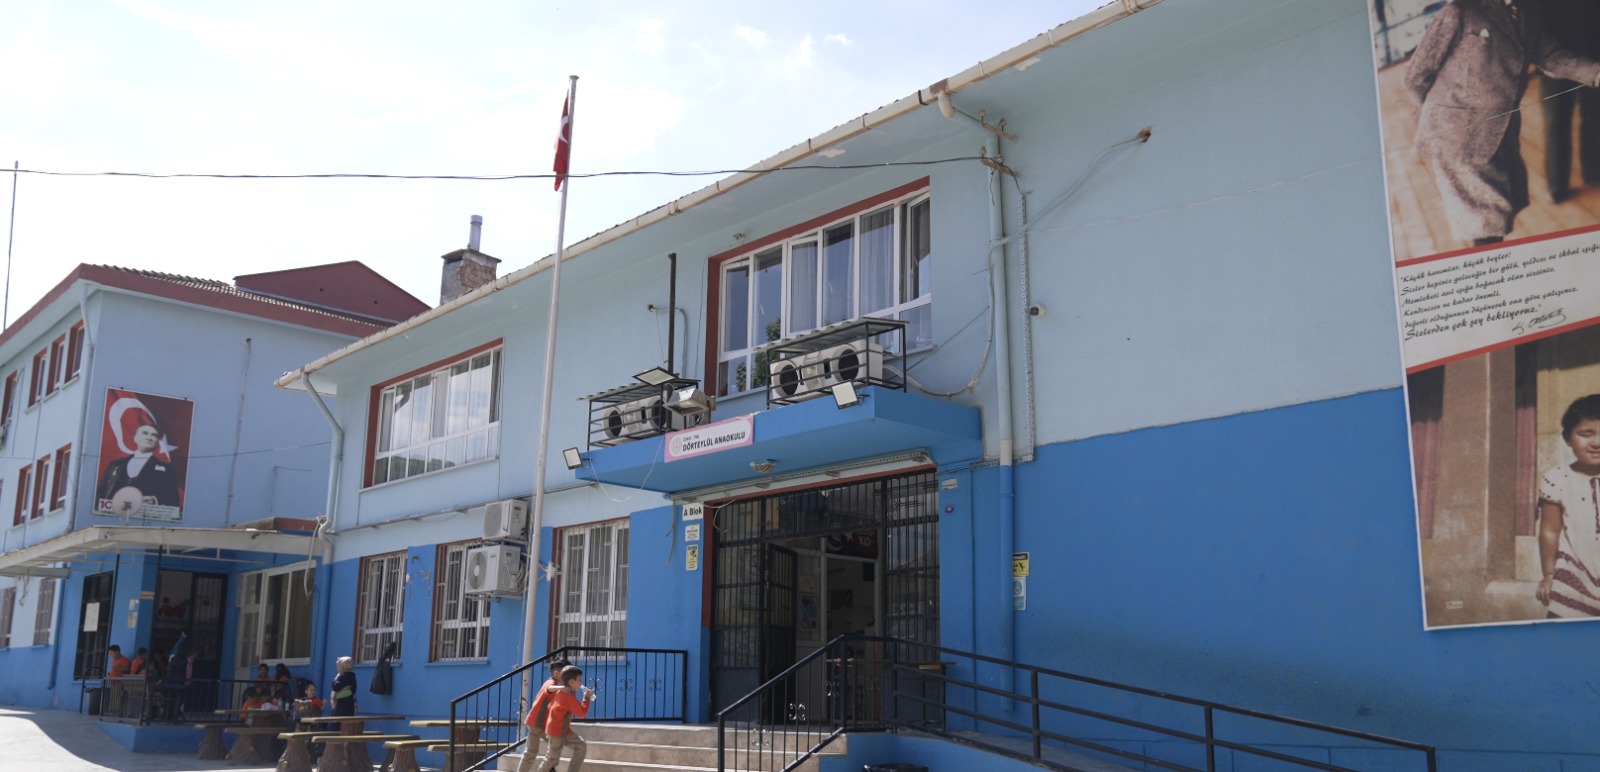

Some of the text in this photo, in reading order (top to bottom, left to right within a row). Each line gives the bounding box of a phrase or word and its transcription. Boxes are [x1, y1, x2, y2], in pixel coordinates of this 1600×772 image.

[1401, 286, 1425, 296] Sizler
[1427, 279, 1452, 289] hepiniz
[1454, 271, 1487, 284] geleceğin
[1558, 248, 1580, 258] ikbal
[1463, 257, 1484, 268] küçük
[1402, 293, 1439, 307] Memleketi
[1475, 276, 1505, 289] boğacak
[1507, 274, 1524, 282] olan
[1404, 318, 1428, 328] değerli
[1471, 300, 1507, 313] düşünerek
[1524, 295, 1540, 304] göre
[1452, 297, 1474, 306] kadar
[1404, 324, 1450, 341] Sizlerden
[1452, 319, 1467, 331] çok
[1469, 318, 1483, 328] şey
[683, 431, 746, 451] DÖRTEYLÜL ANAOKULU
[689, 506, 702, 516] Blok
